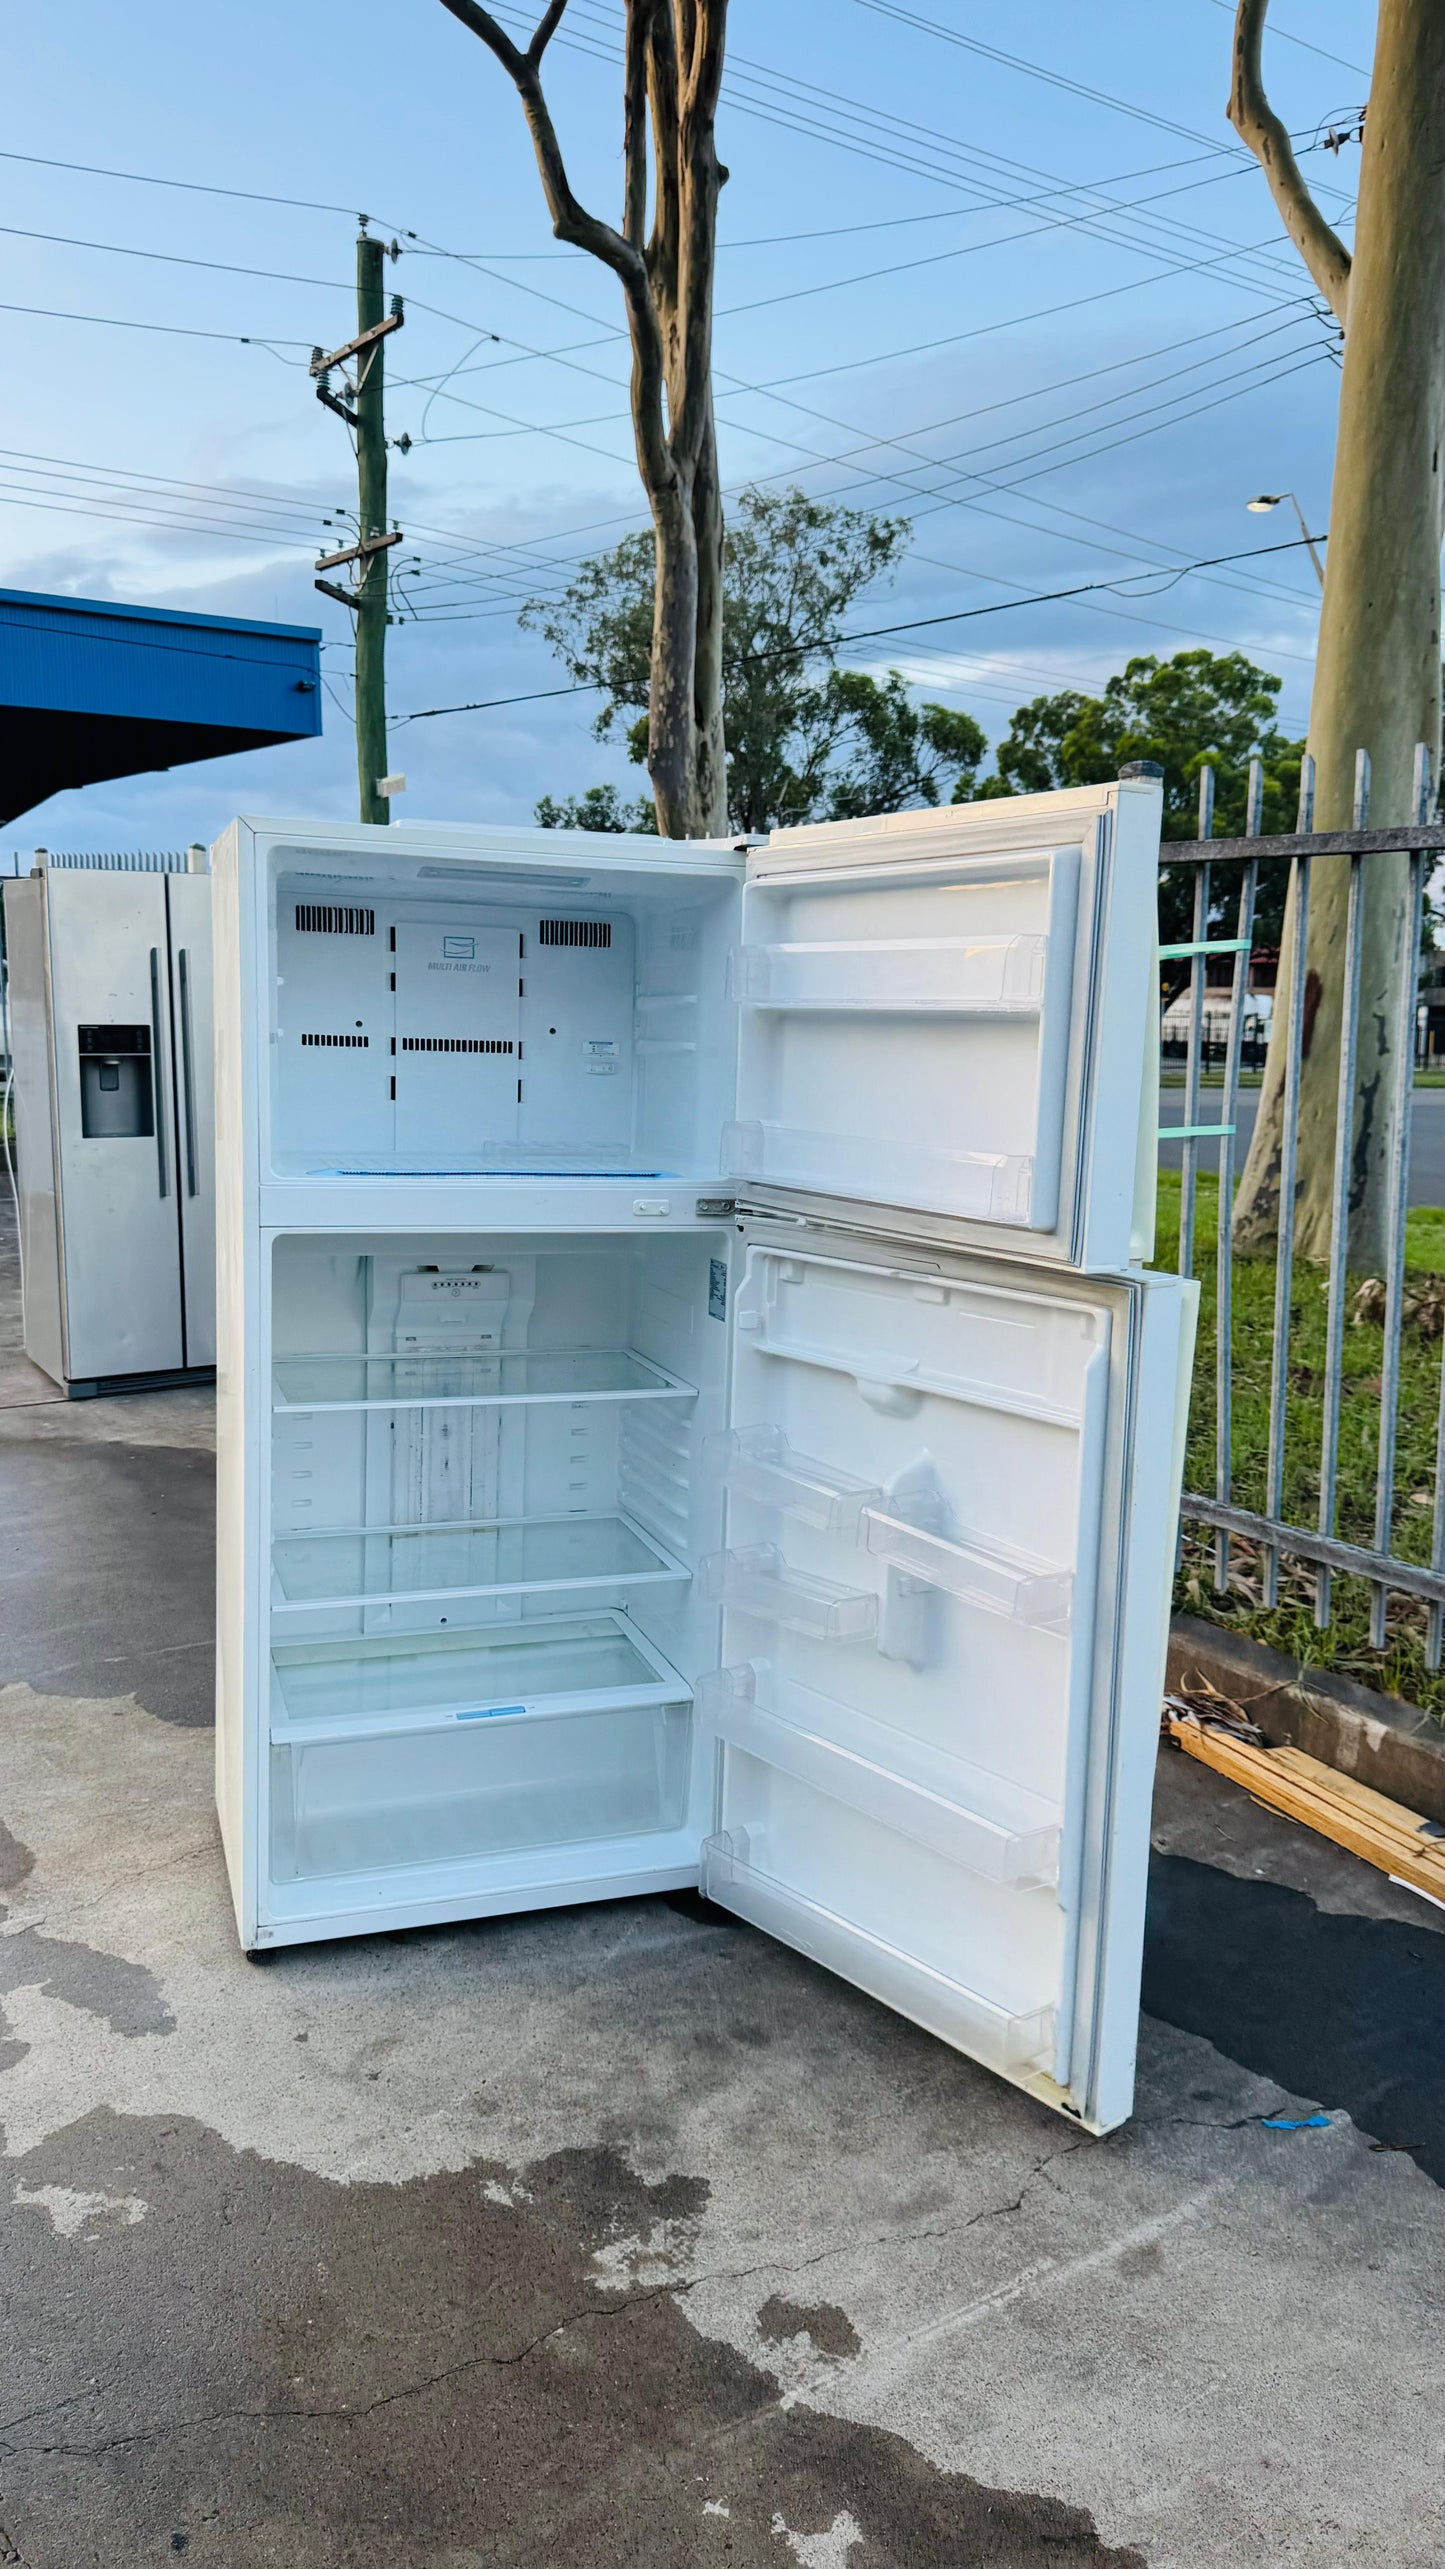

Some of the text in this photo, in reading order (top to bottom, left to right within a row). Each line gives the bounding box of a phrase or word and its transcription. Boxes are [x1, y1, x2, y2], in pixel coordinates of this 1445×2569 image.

[428, 961, 491, 973] MULTI AIR FLOW
